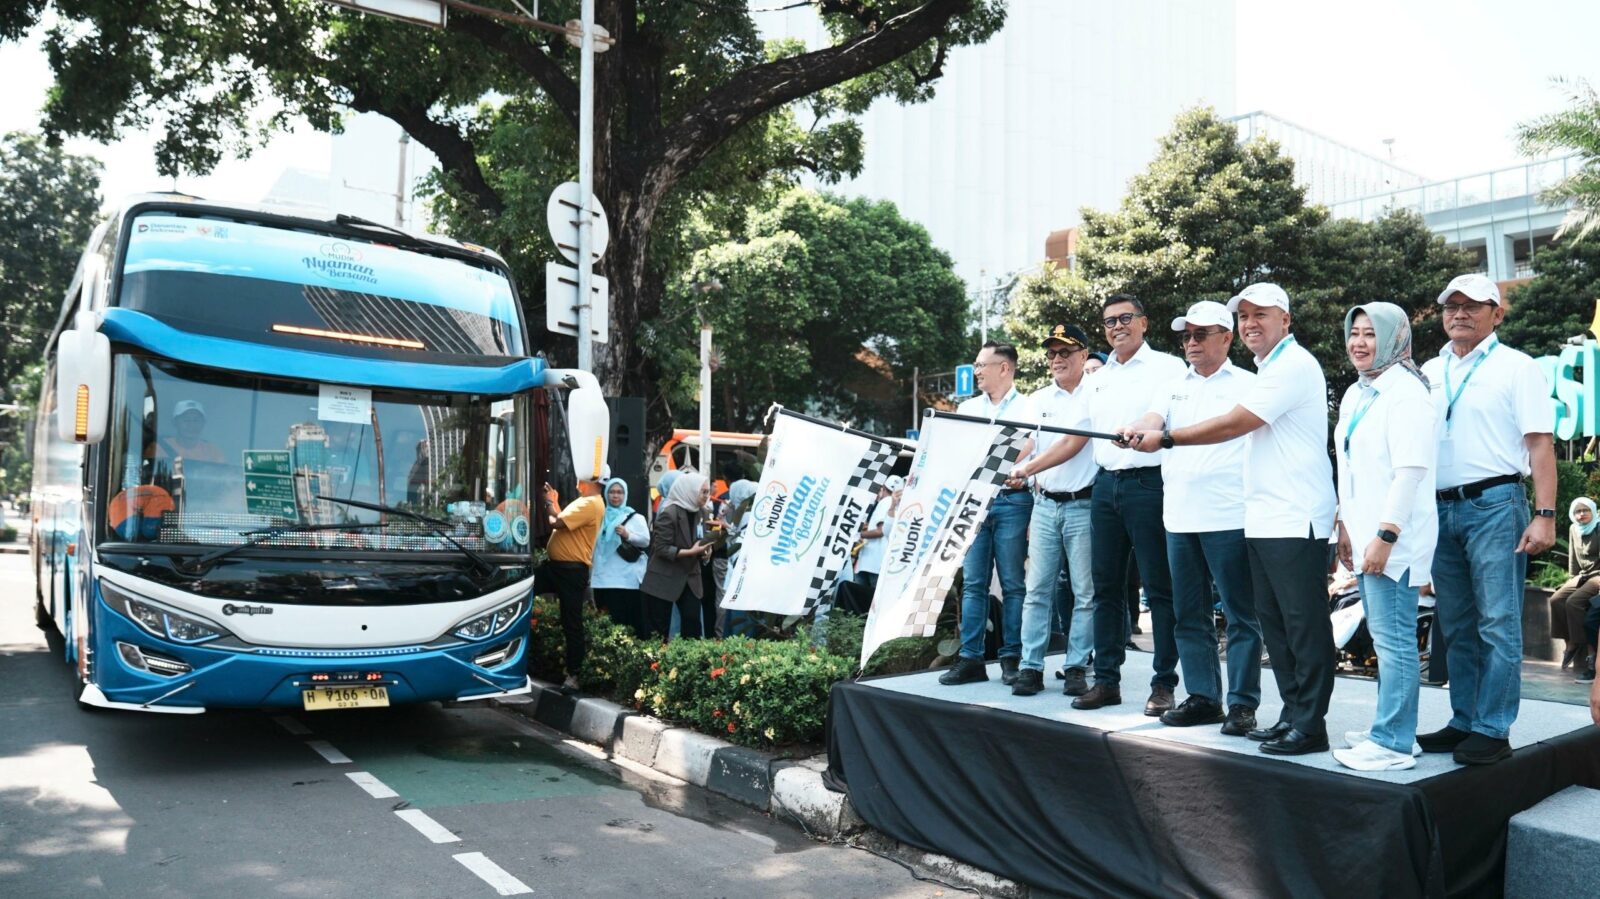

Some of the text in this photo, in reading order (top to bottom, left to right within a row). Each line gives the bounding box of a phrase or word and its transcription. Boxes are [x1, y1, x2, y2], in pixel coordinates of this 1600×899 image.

[302, 257, 376, 277] Nyaman
[327, 268, 379, 285] Bersama
[767, 494, 787, 529] MUDIK
[771, 475, 816, 565] Nyaman
[795, 476, 831, 540] Bersama
[831, 497, 862, 559] START
[941, 494, 982, 562] START
[900, 517, 924, 563] MUDIK
[307, 691, 315, 703] H
